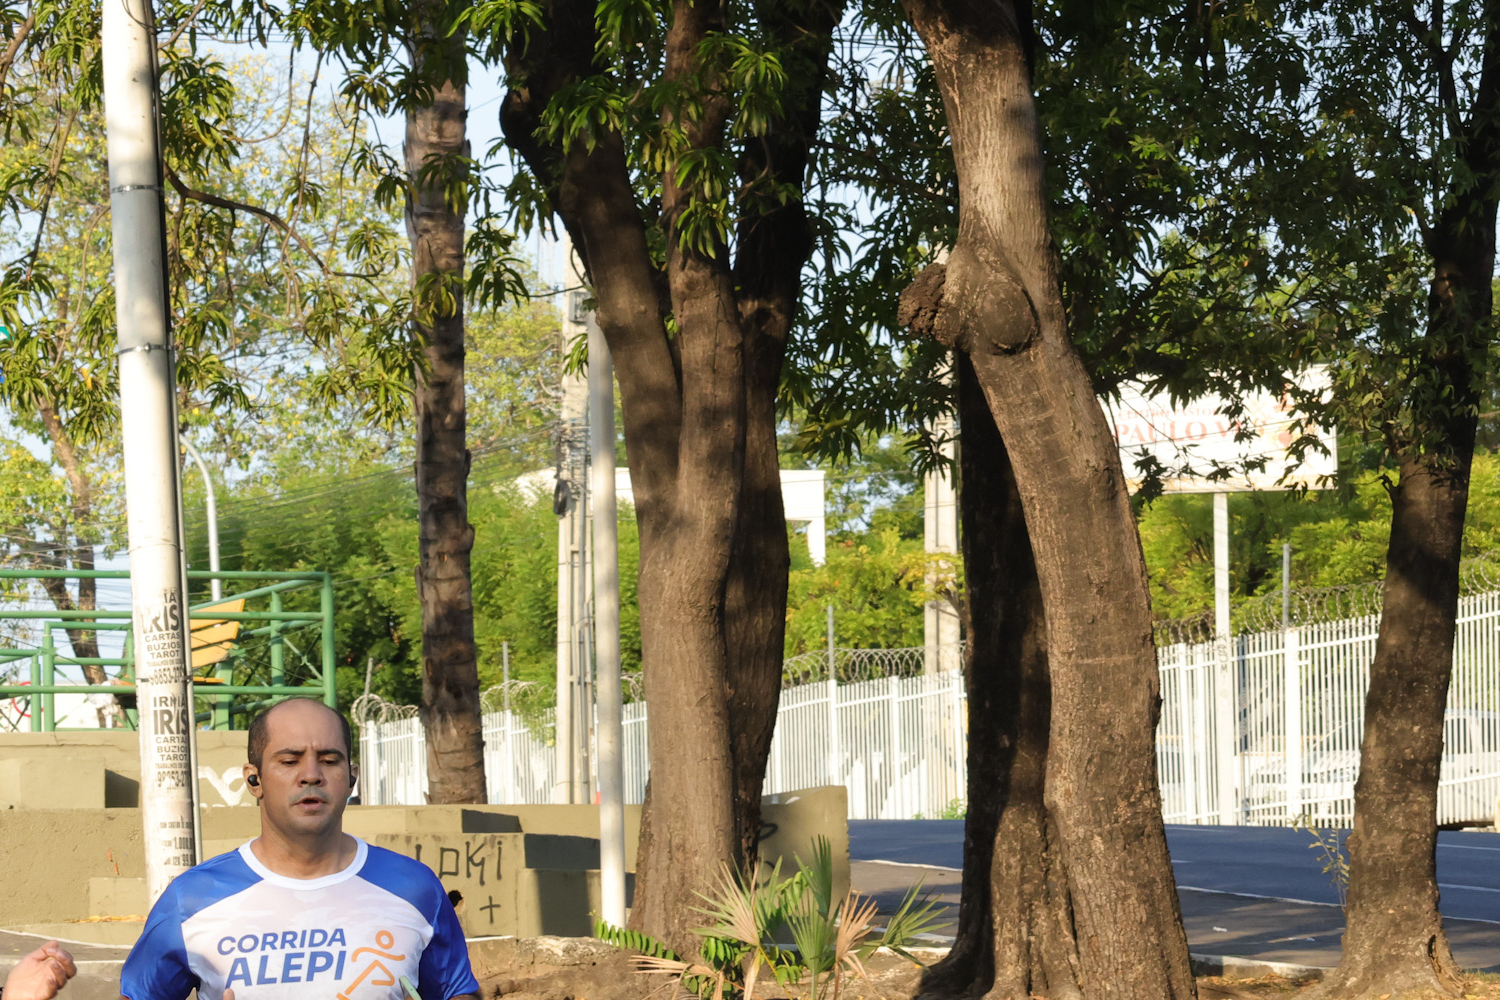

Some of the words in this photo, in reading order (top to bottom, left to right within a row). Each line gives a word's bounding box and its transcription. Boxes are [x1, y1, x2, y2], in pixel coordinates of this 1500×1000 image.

[1116, 421, 1207, 443] PAULO
[145, 632, 181, 642] CARTAS
[150, 650, 180, 659] TAROT
[154, 709, 188, 735] IRIS
[156, 736, 188, 744] CARTA
[160, 754, 188, 762] TAROT
[217, 928, 346, 955] CORRIDA
[225, 950, 346, 988] ALEPI
